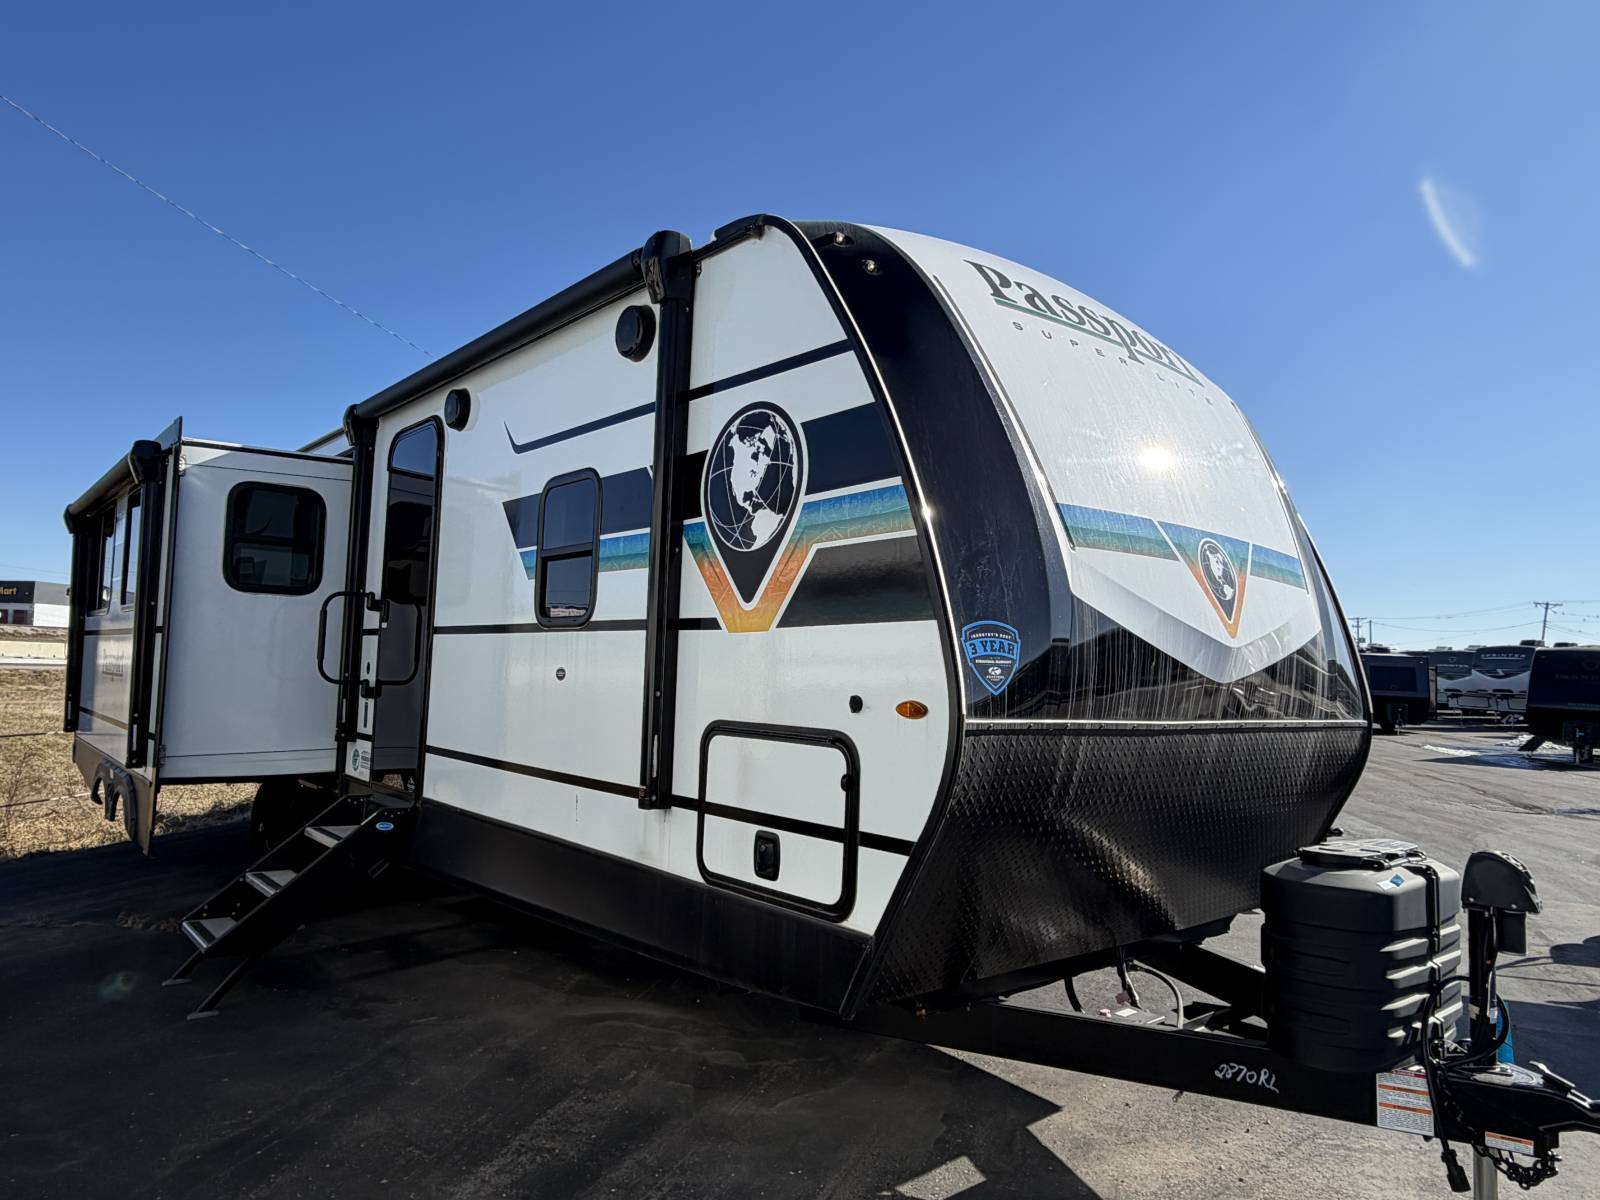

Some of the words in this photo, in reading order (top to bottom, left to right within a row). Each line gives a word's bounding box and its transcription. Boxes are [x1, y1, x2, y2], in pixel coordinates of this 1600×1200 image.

[963, 259, 1203, 386] Passport
[1012, 321, 1129, 366] SUPER
[969, 643, 978, 655] 3
[980, 640, 1015, 656] YEAR
[1214, 1062, 1280, 1094] 2870RL
